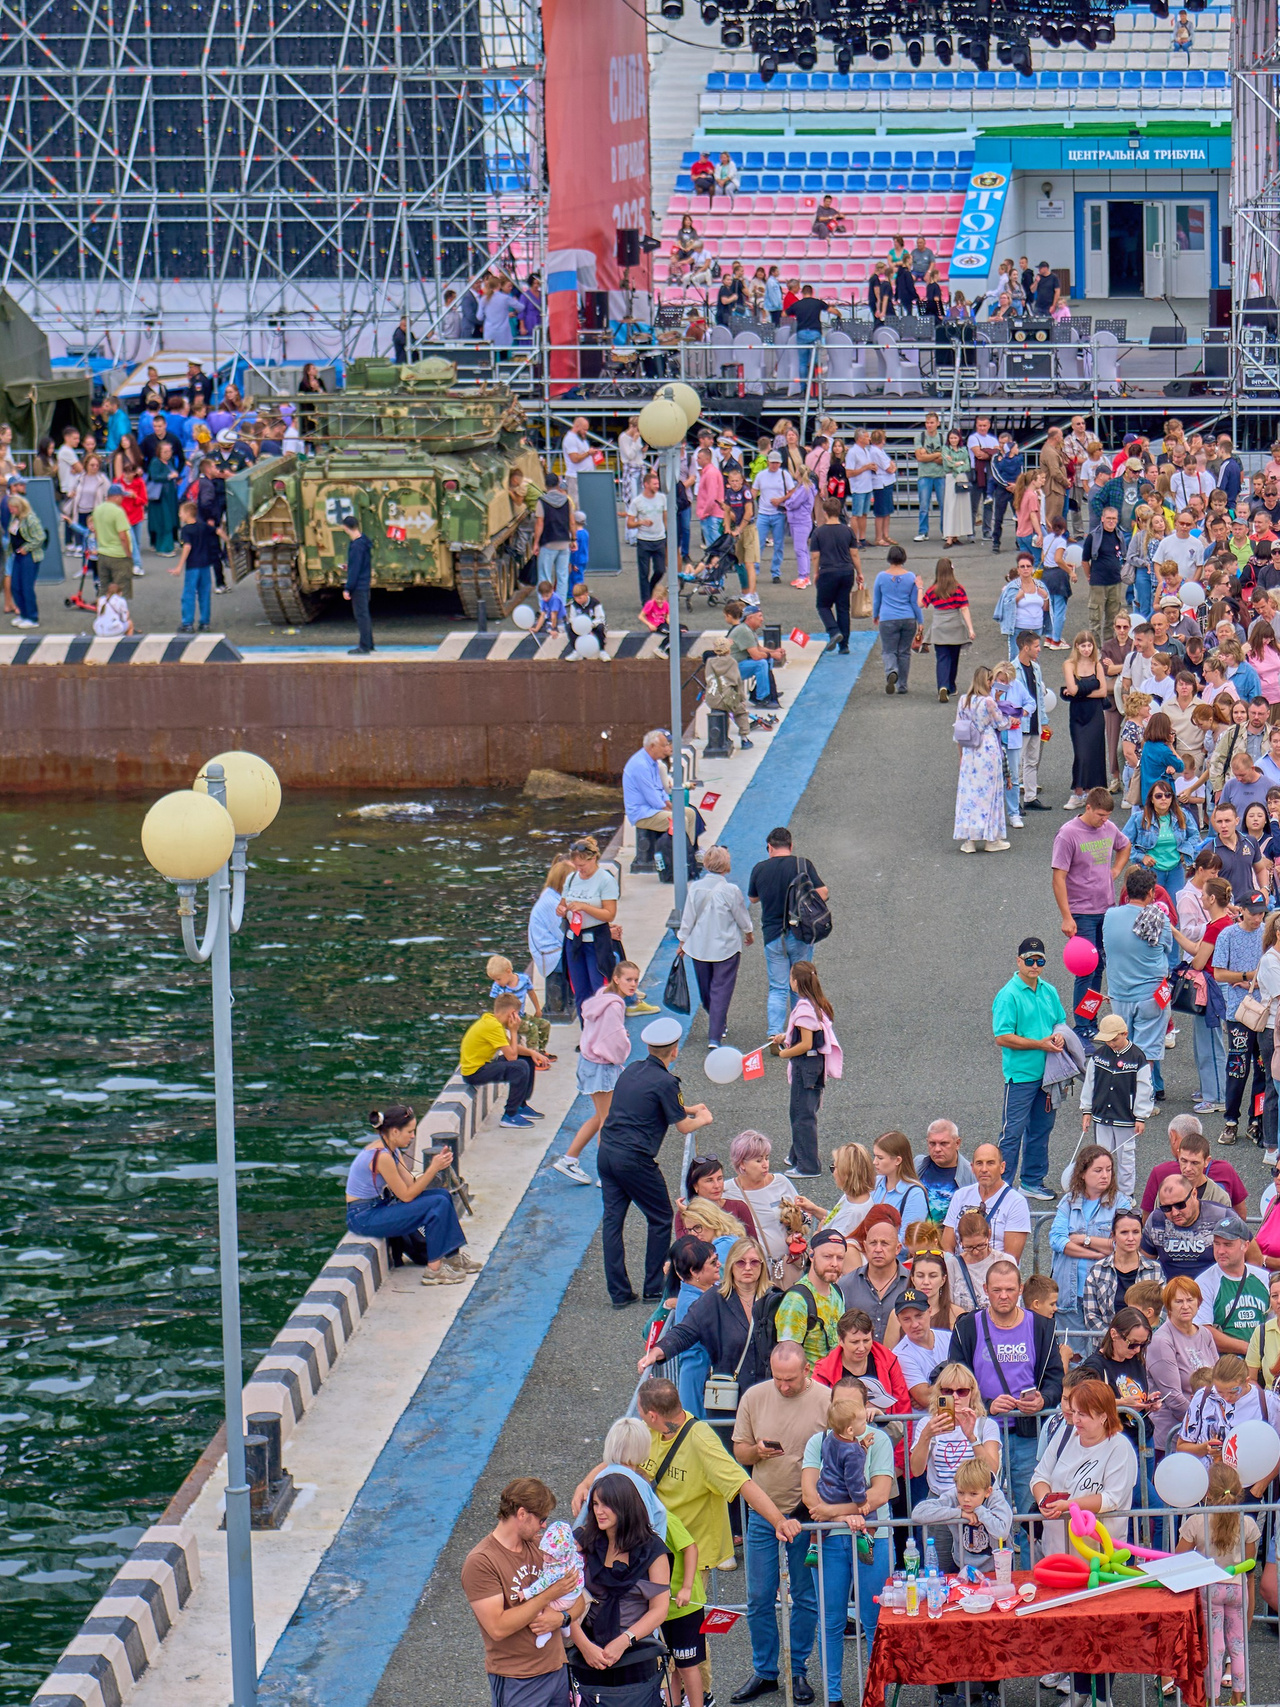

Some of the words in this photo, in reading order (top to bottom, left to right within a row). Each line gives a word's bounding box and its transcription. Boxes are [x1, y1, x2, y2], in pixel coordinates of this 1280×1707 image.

[609, 53, 646, 124] СИЛА
[611, 146, 617, 183] В
[1068, 150, 1150, 161] ЦЕНТРАЛЬНАЯ
[1153, 150, 1206, 160] ТРИБУНА
[1164, 1239, 1206, 1254] JEANS
